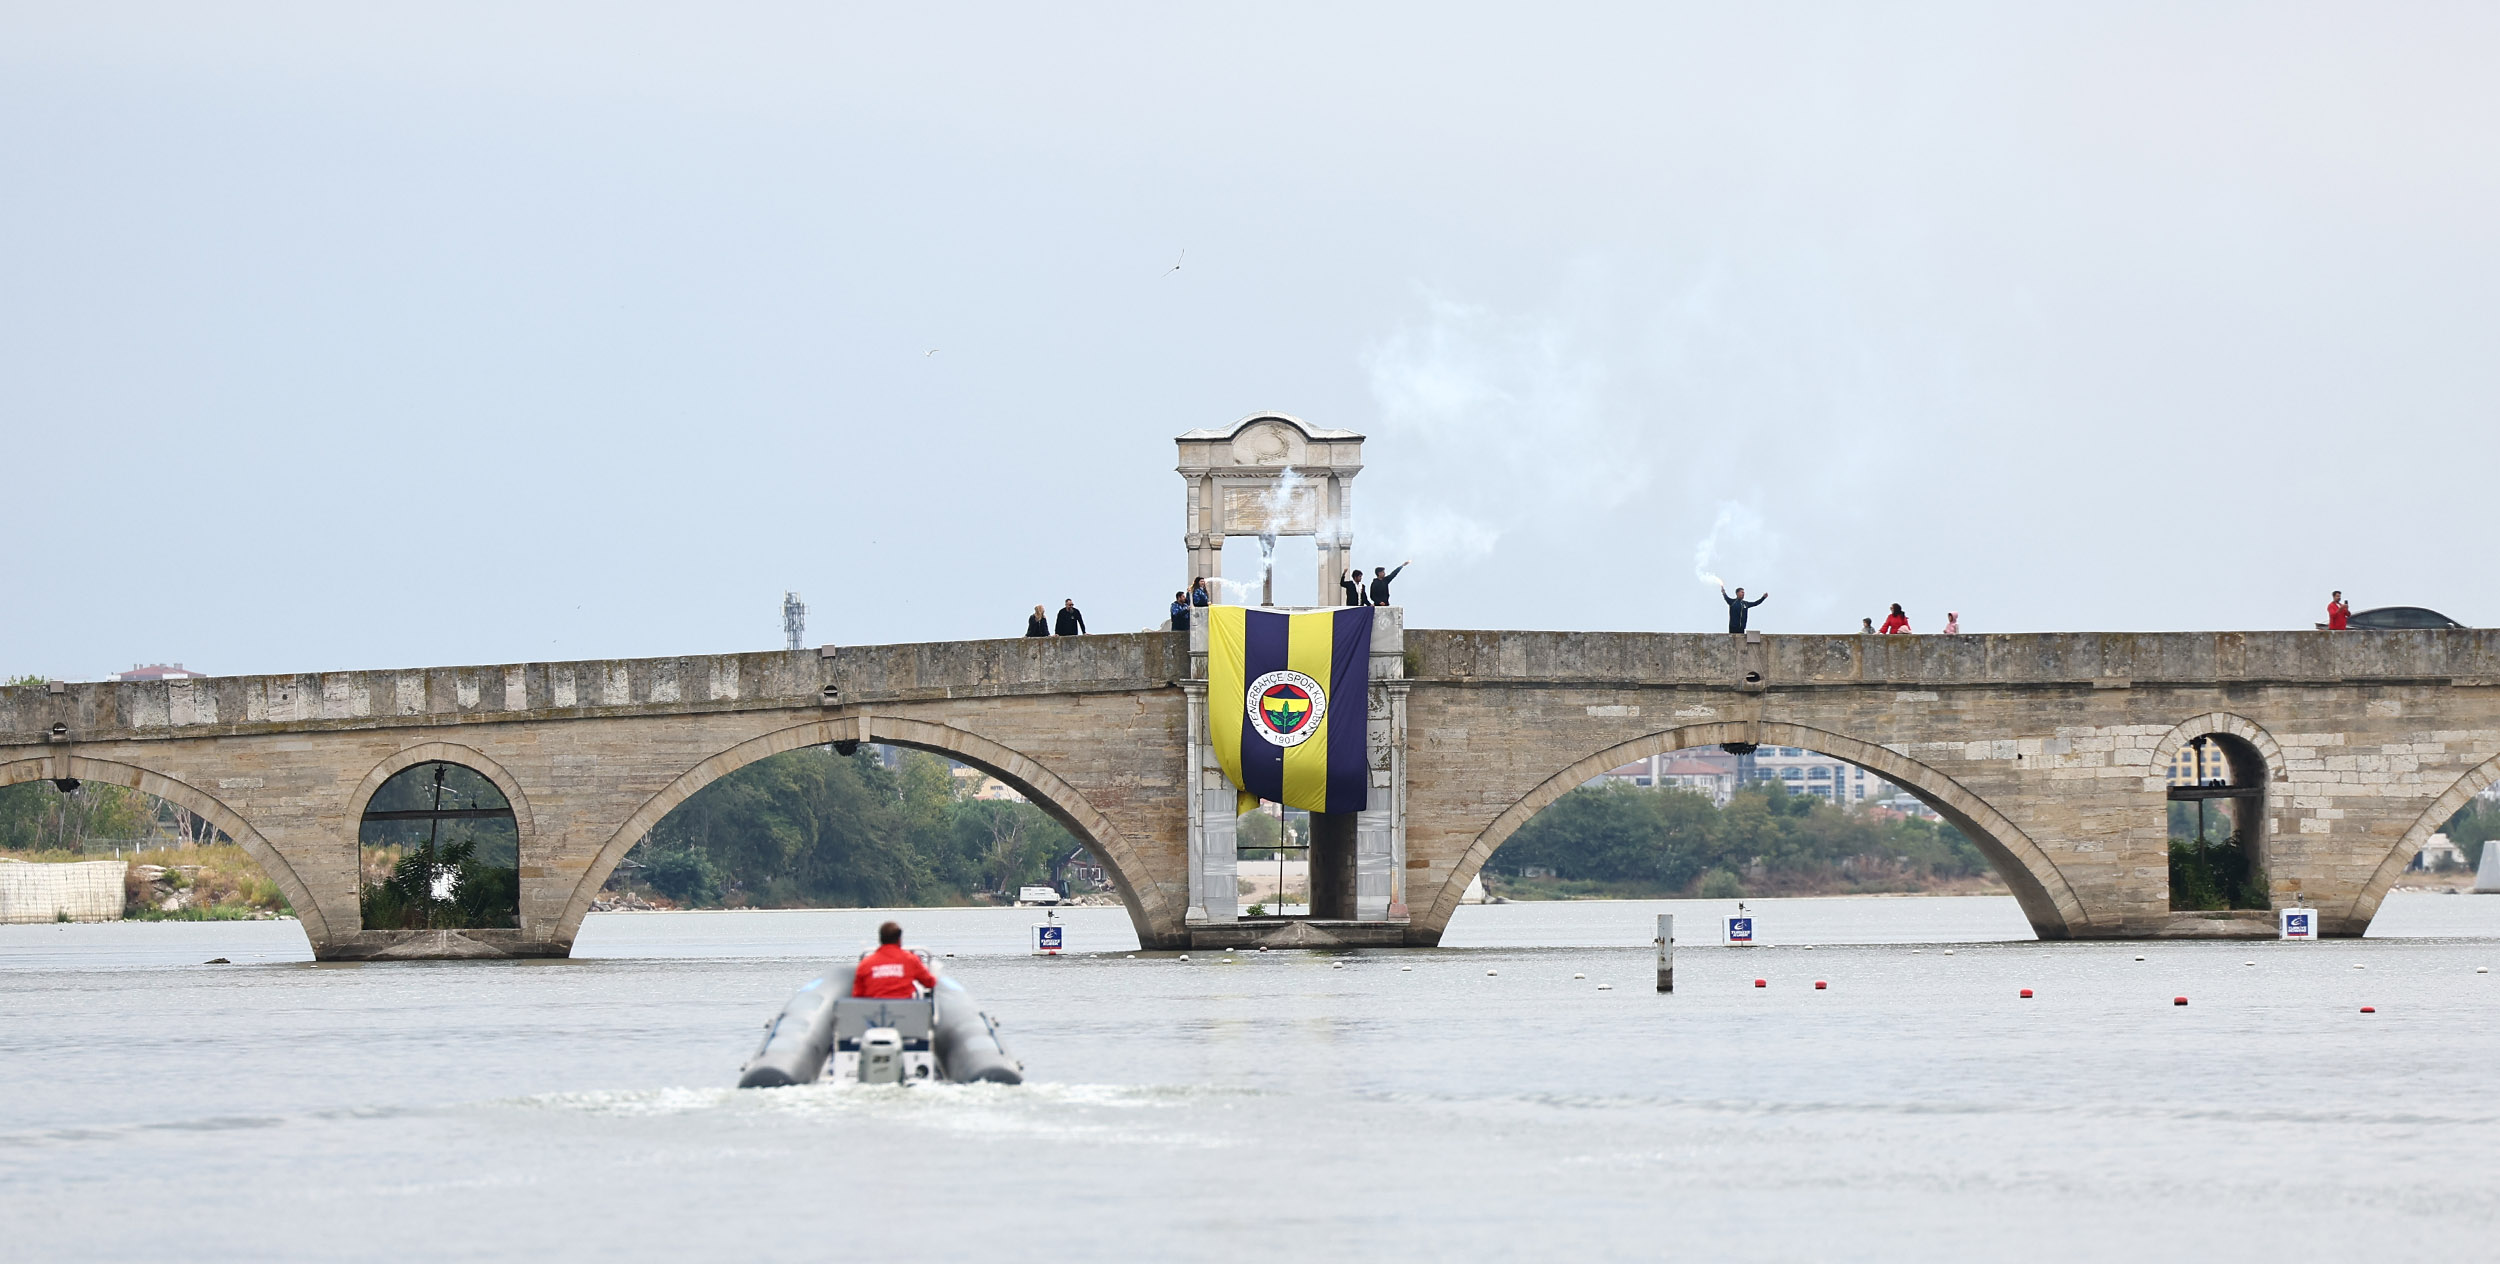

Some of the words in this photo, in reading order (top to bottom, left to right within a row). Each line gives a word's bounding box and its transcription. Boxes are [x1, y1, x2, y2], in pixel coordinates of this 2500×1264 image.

[1248, 672, 1284, 727] FENERBAHÇE
[1287, 672, 1315, 692] SPOR
[1274, 735, 1296, 744] 1907
